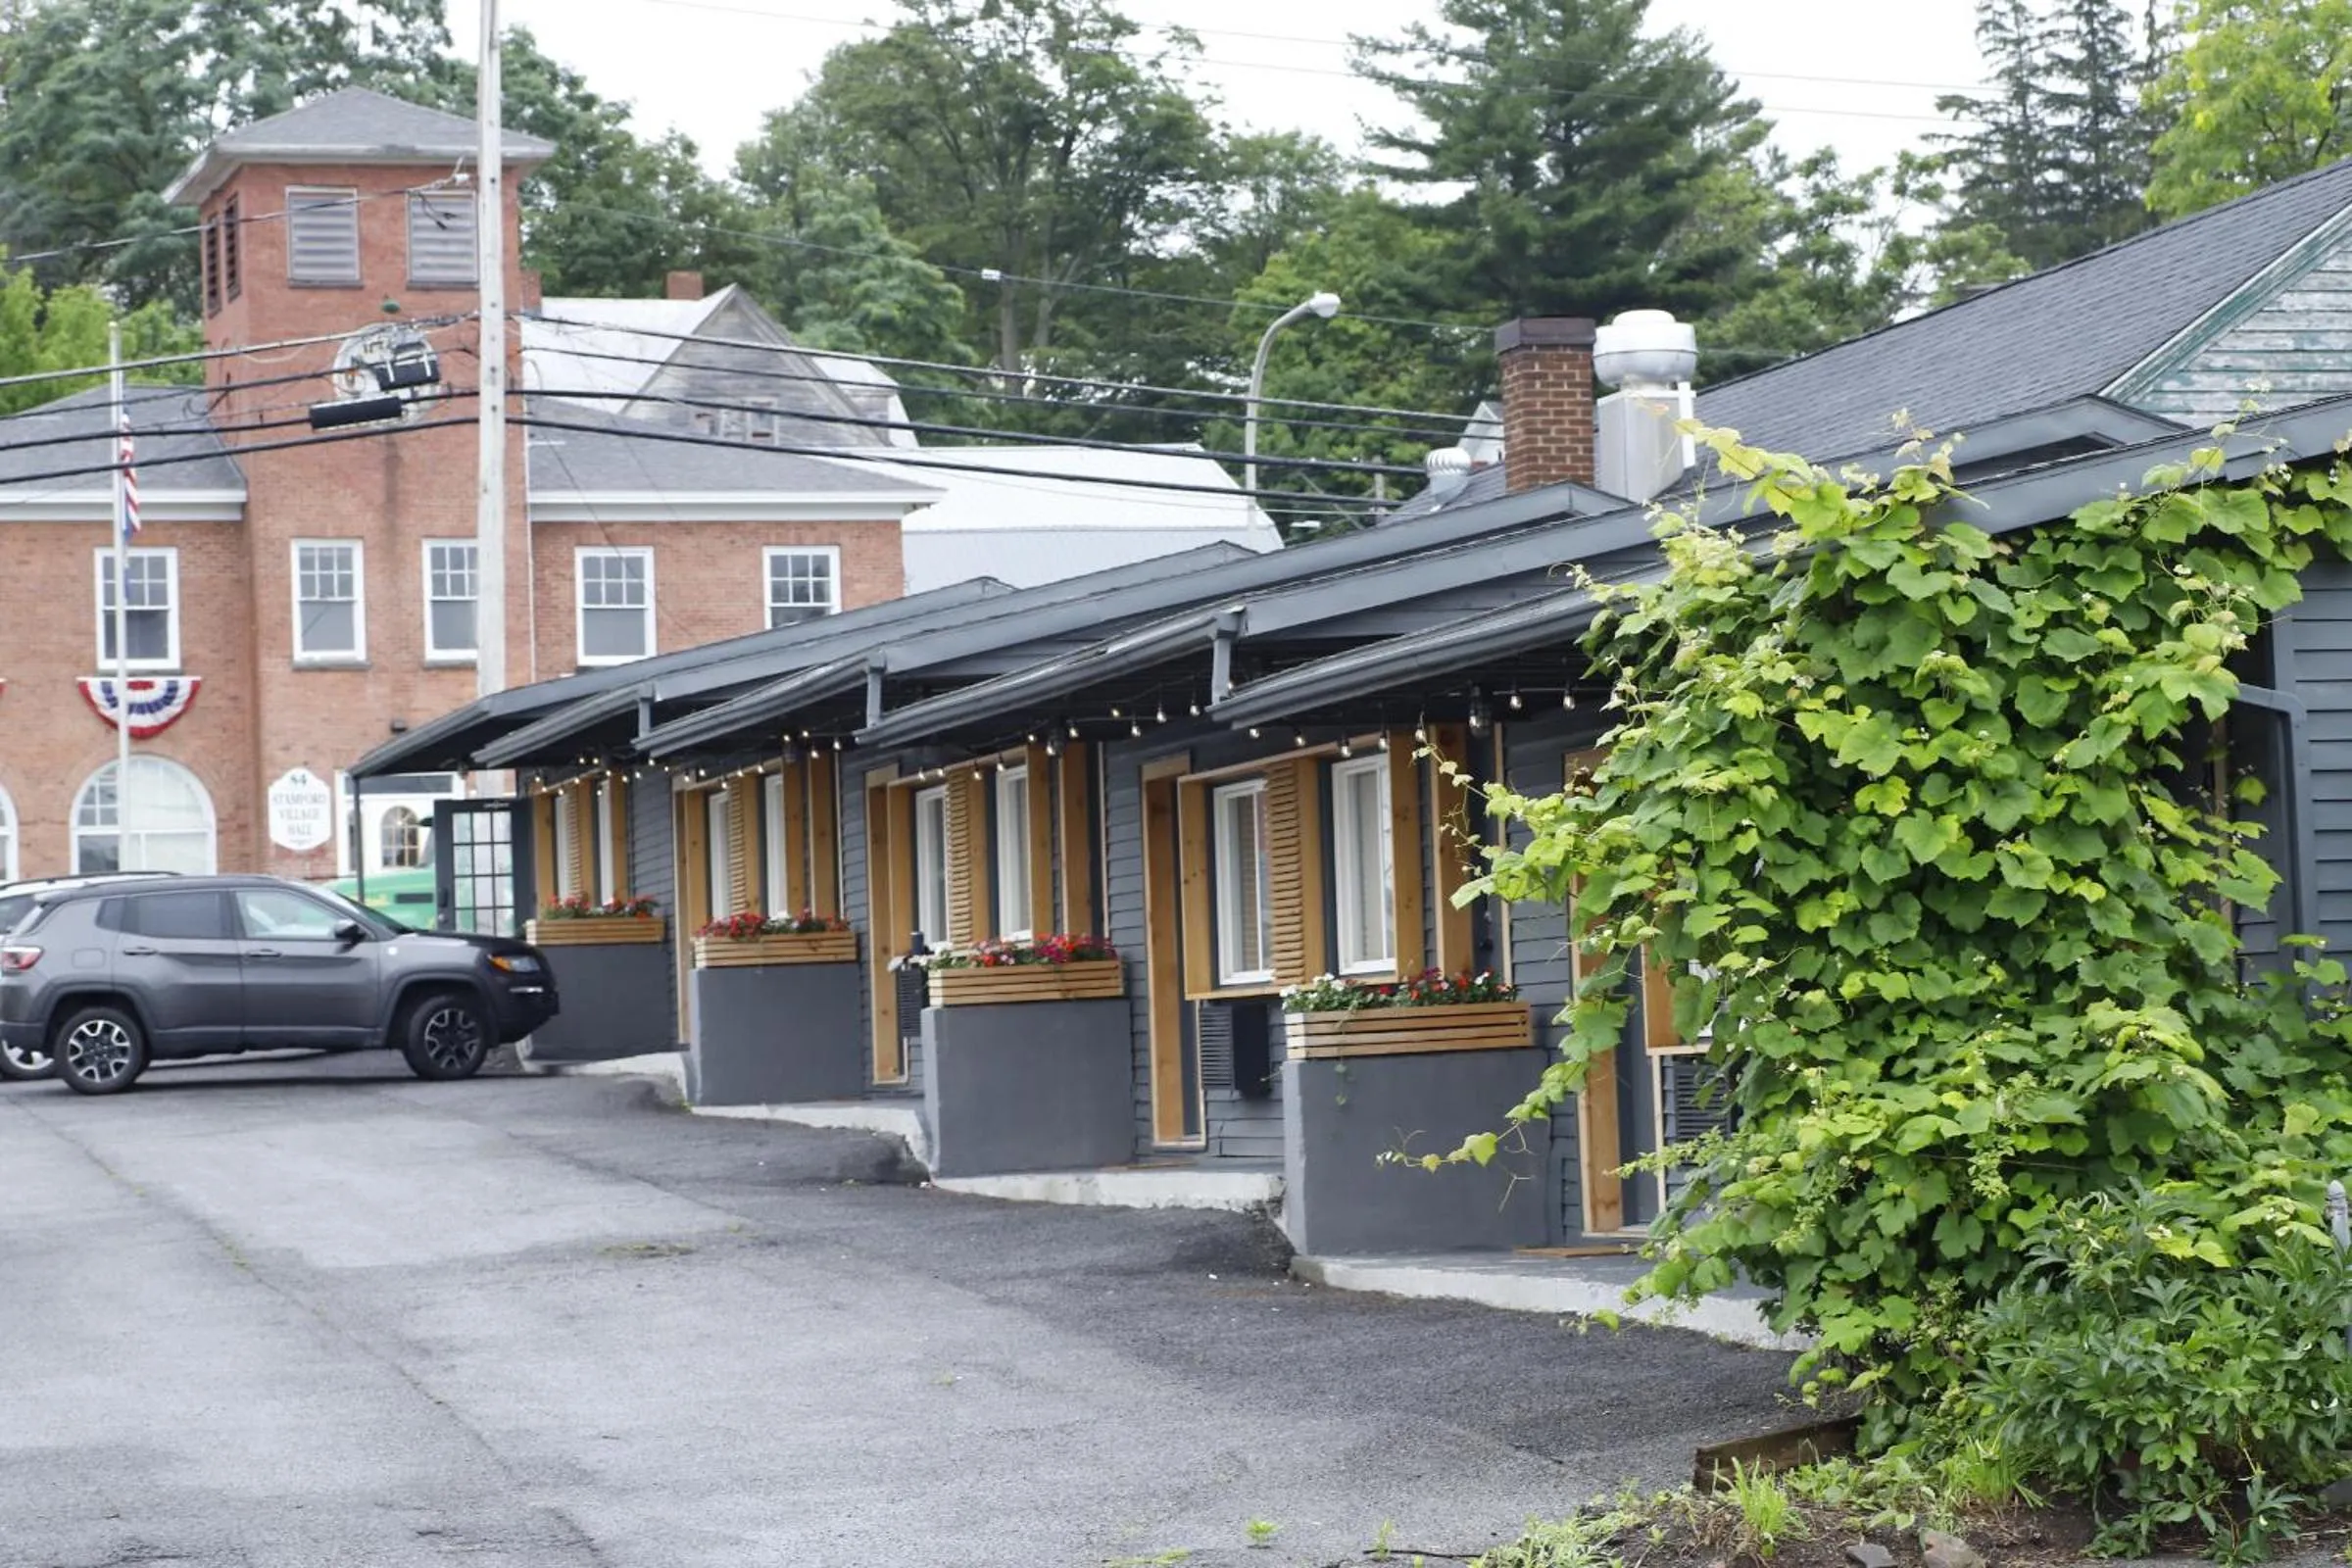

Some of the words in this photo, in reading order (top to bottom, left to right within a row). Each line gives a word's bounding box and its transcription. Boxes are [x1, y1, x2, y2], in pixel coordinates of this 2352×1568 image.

[271, 793, 327, 805] STAMFORD
[278, 808, 320, 820] VILLAGE
[287, 822, 313, 836] HALL
